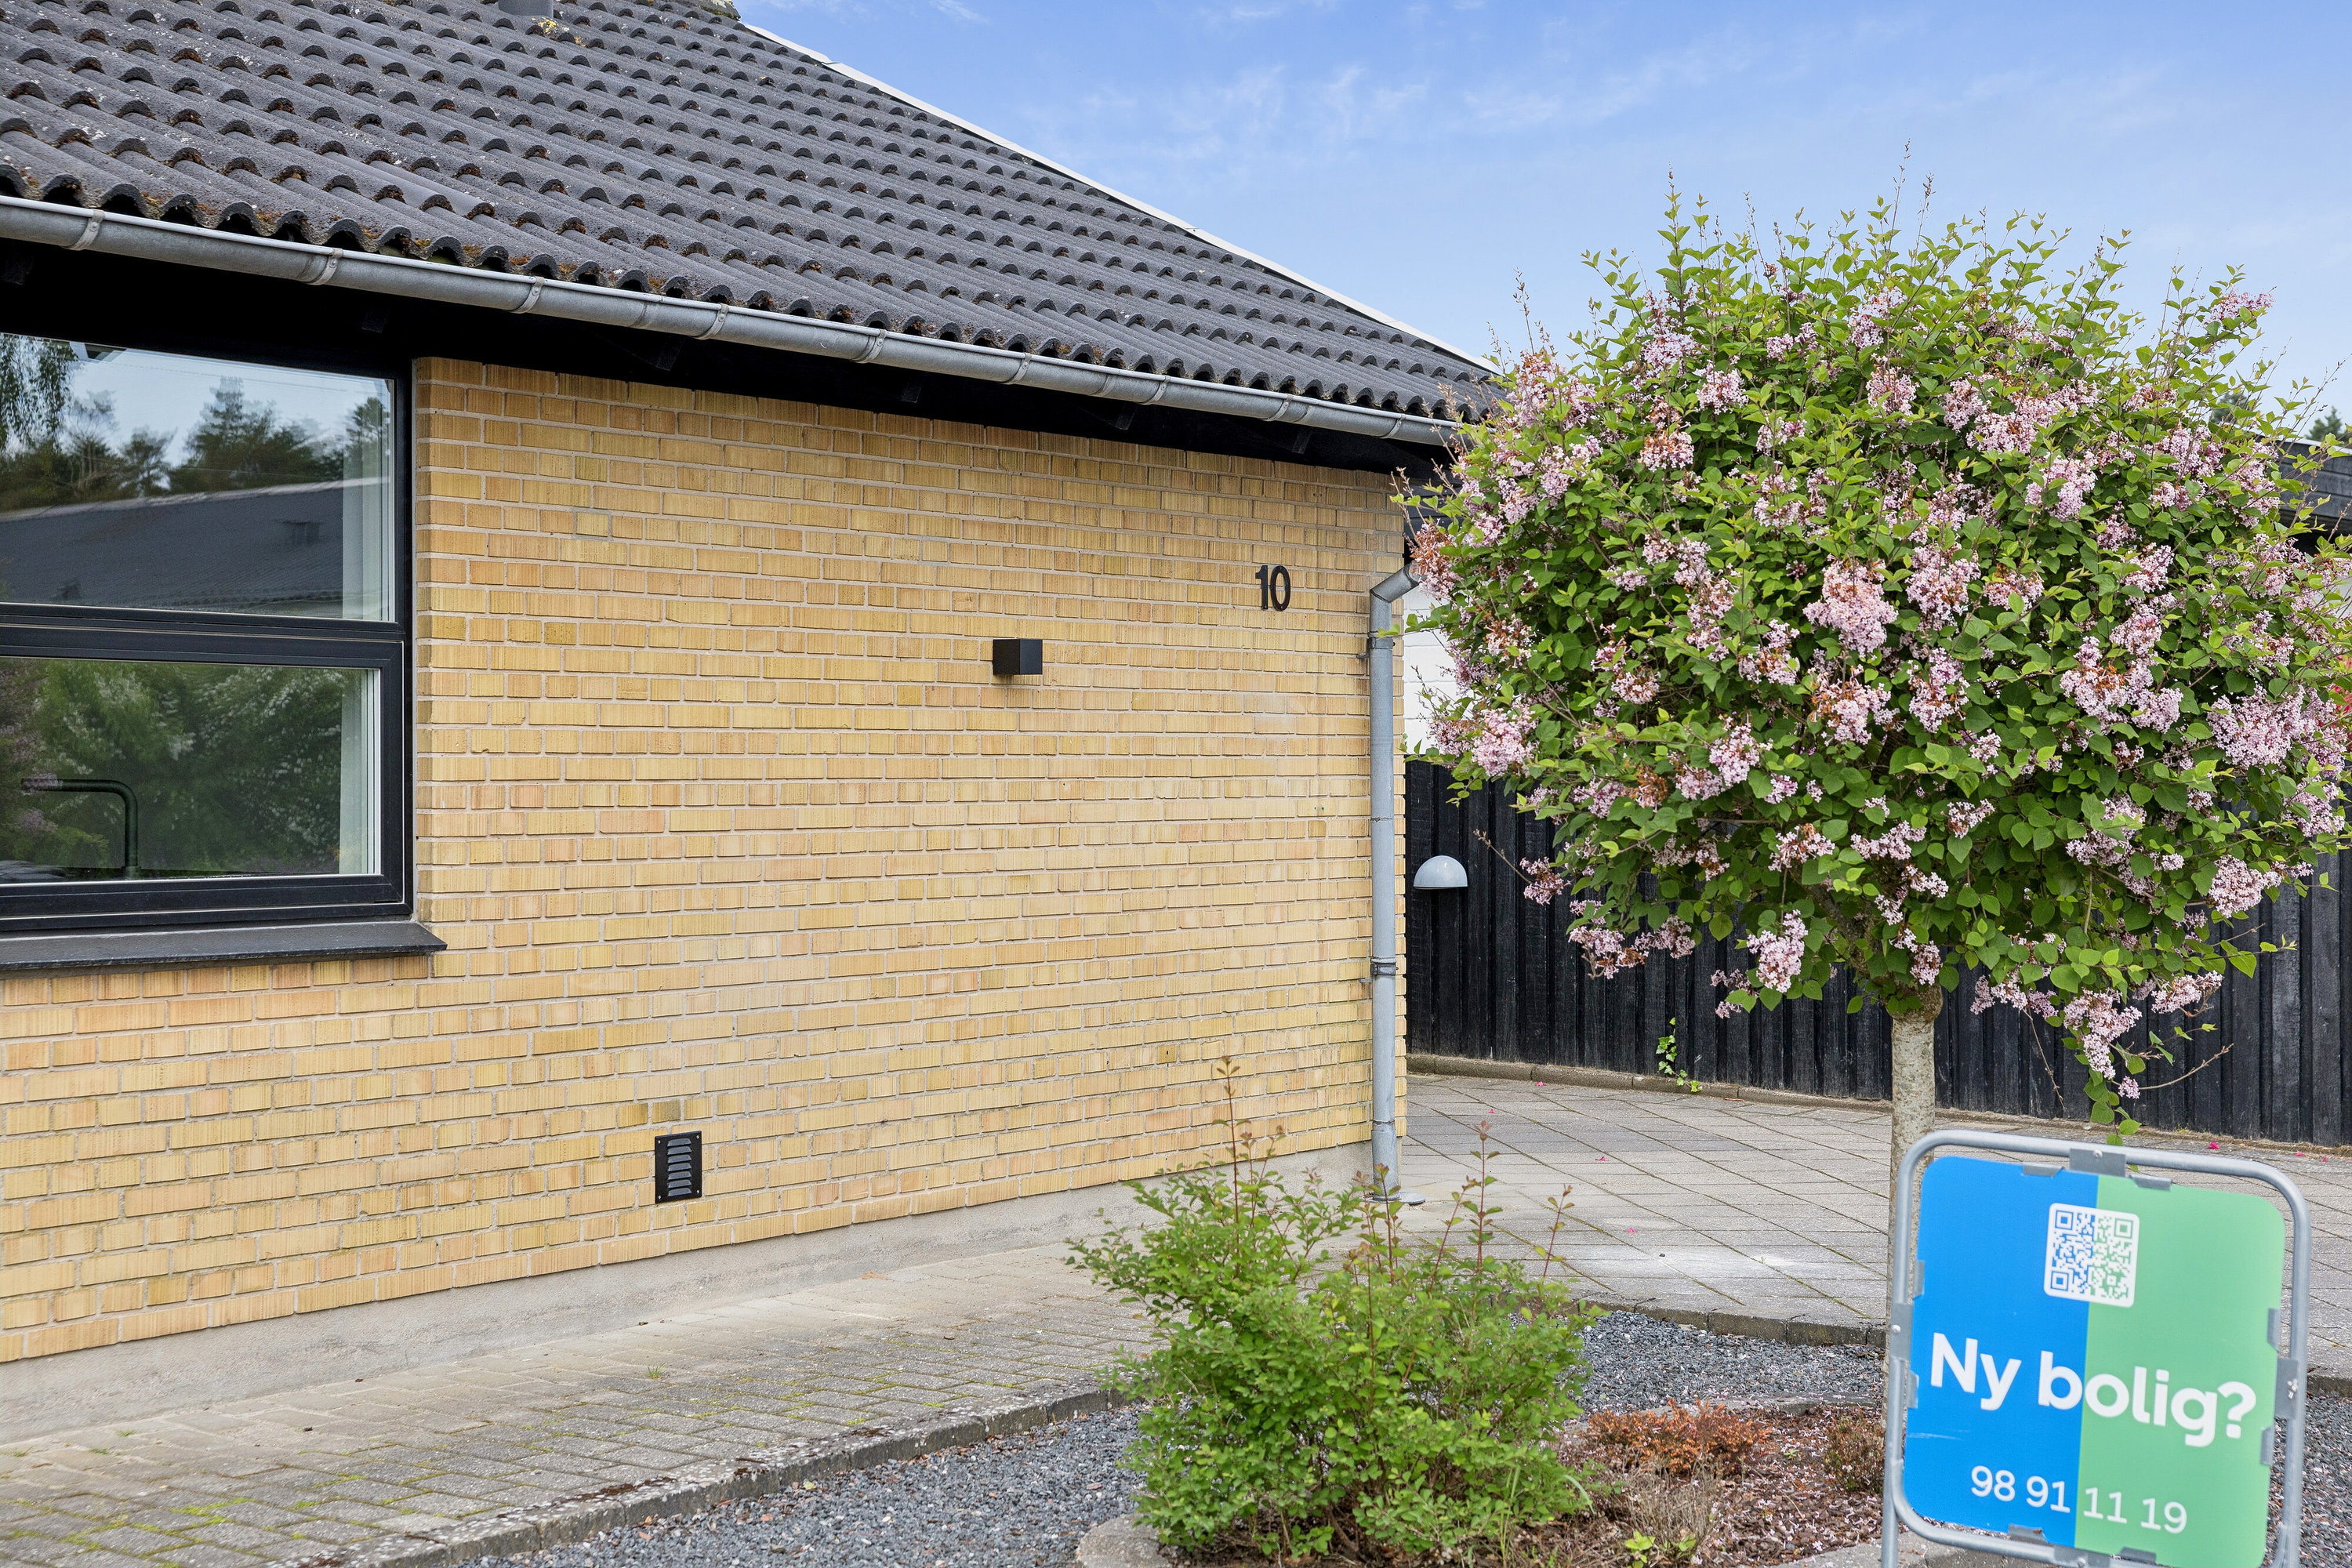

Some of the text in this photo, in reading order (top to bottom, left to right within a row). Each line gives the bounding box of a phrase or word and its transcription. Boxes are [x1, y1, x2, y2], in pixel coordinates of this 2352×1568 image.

[1255, 564, 1290, 612] 10
[1930, 1332, 2256, 1447] Ny bolig?
[1970, 1465, 2187, 1534] 98 91 11 19
